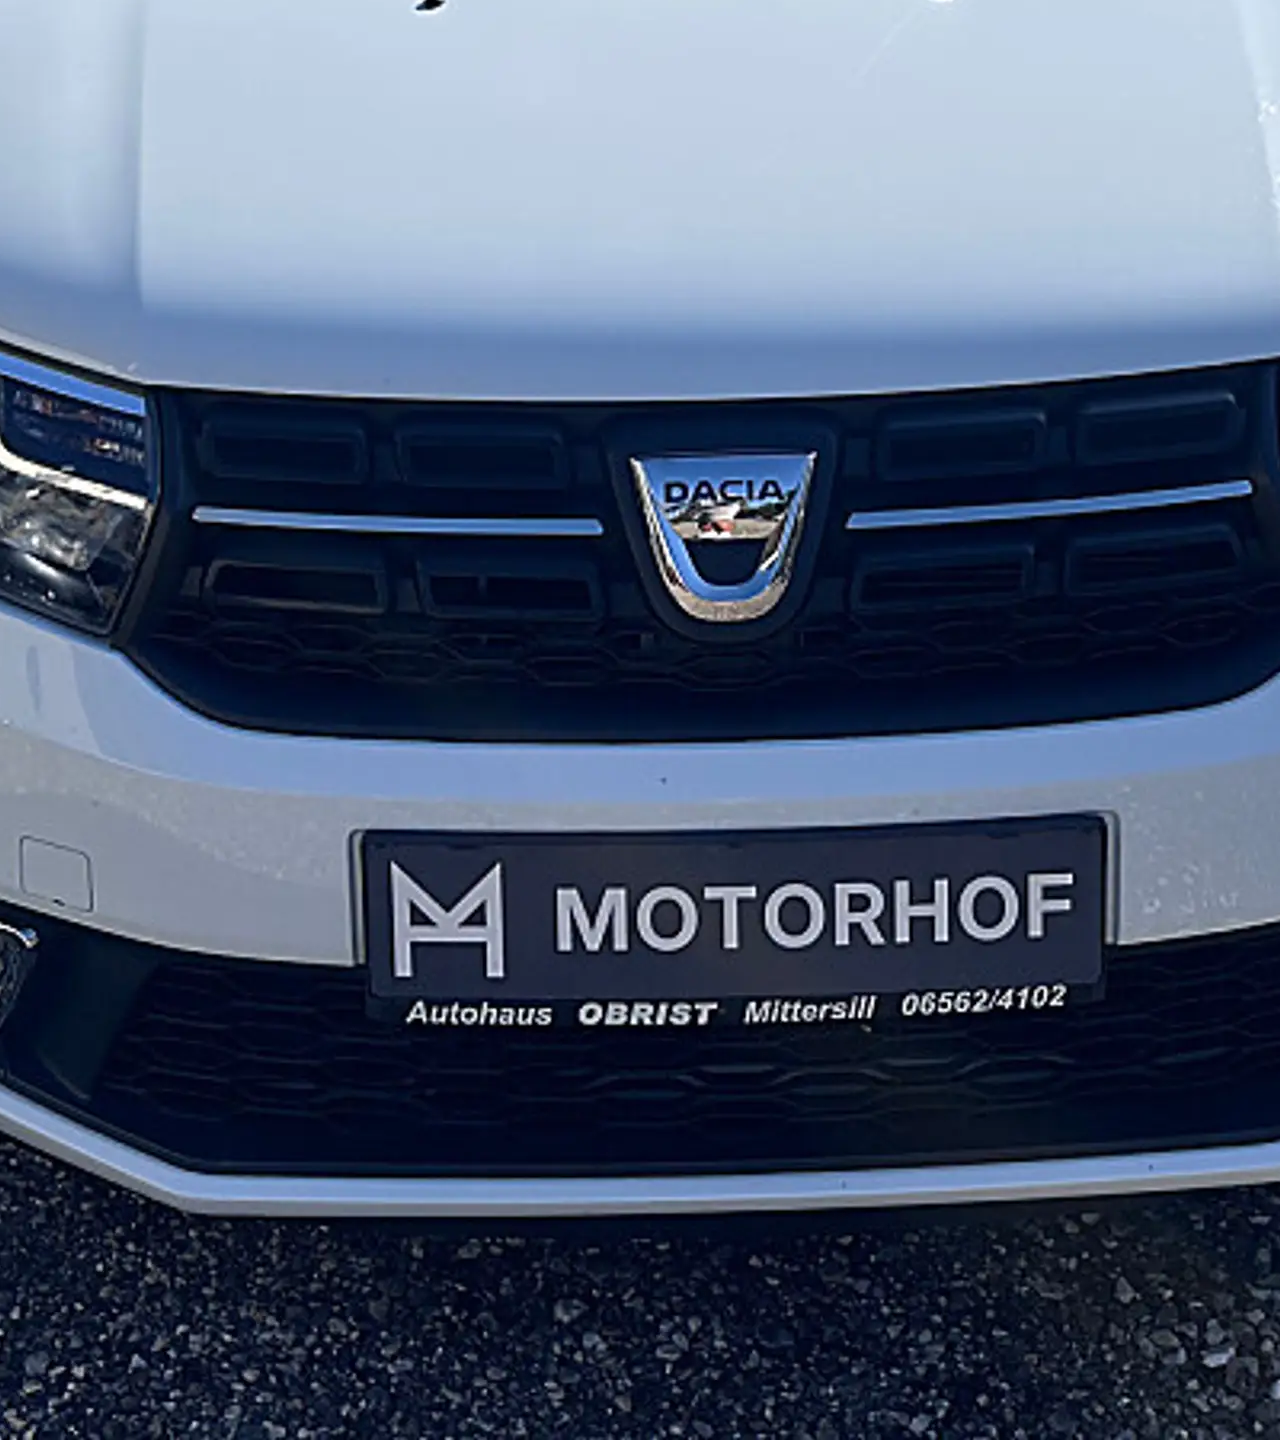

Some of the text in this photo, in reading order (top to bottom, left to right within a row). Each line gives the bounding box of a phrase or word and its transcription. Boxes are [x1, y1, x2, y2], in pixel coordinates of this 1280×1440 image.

[665, 479, 784, 503] DACIA
[556, 873, 1074, 952] MOTORHOF
[406, 984, 1068, 1026] Autohaus OBRIST Mittersill 06562/4102
